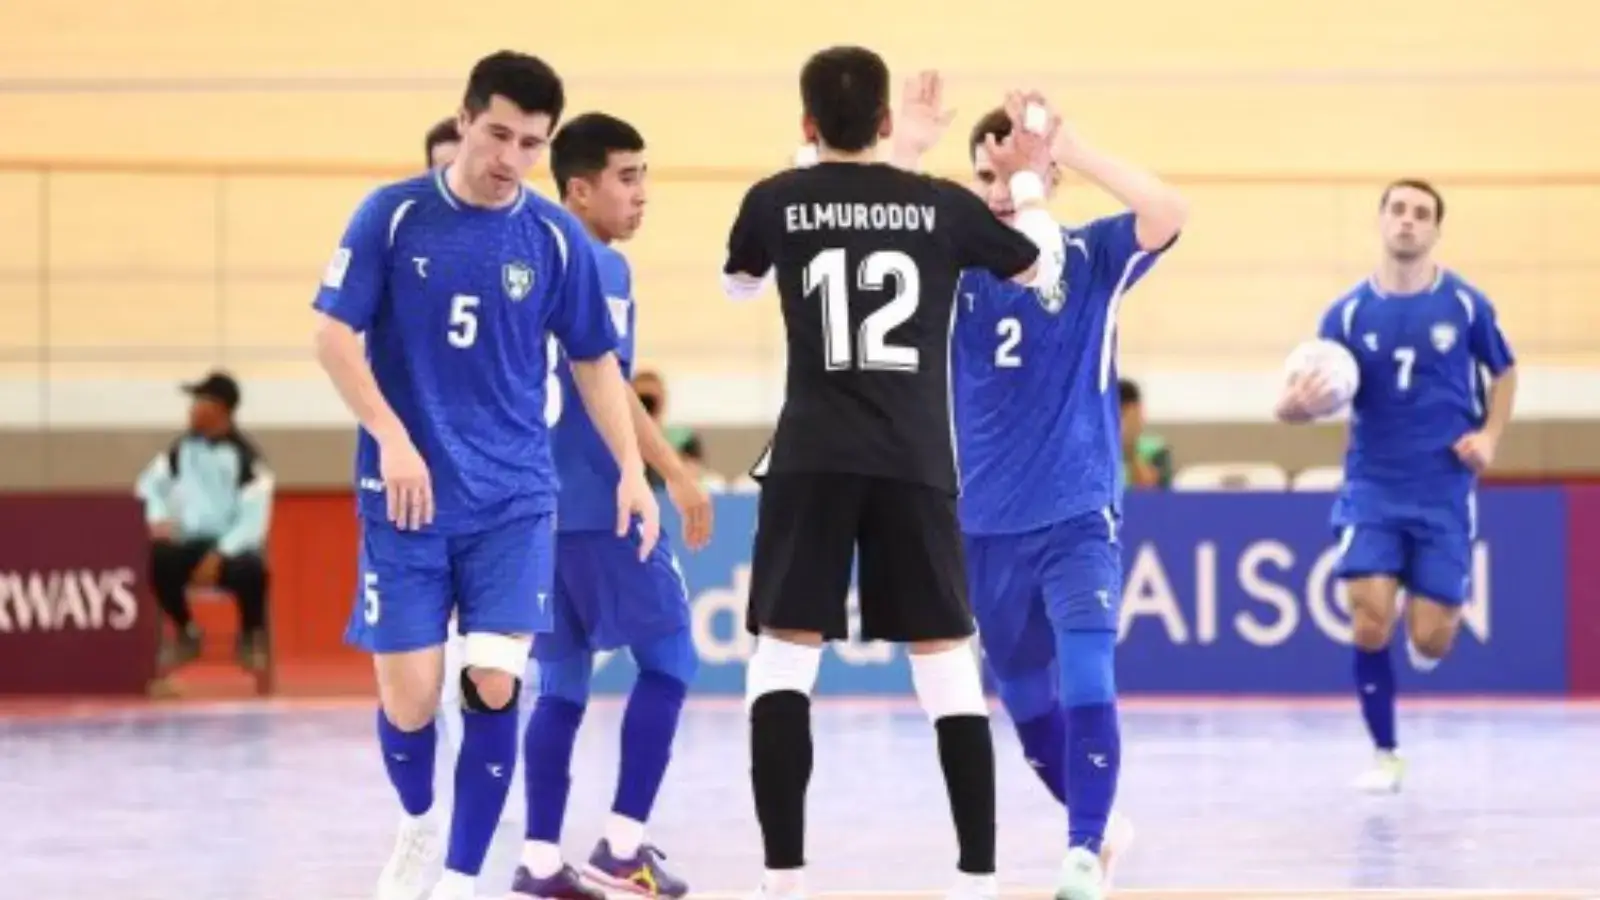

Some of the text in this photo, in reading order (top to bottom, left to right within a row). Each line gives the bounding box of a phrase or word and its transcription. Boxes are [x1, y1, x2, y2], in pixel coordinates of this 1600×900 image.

[786, 202, 936, 233] ELMURODOV
[447, 295, 480, 349] 5
[802, 247, 920, 373] 12
[995, 318, 1023, 368] 2
[1394, 347, 1415, 391] 7
[364, 573, 379, 625] 5
